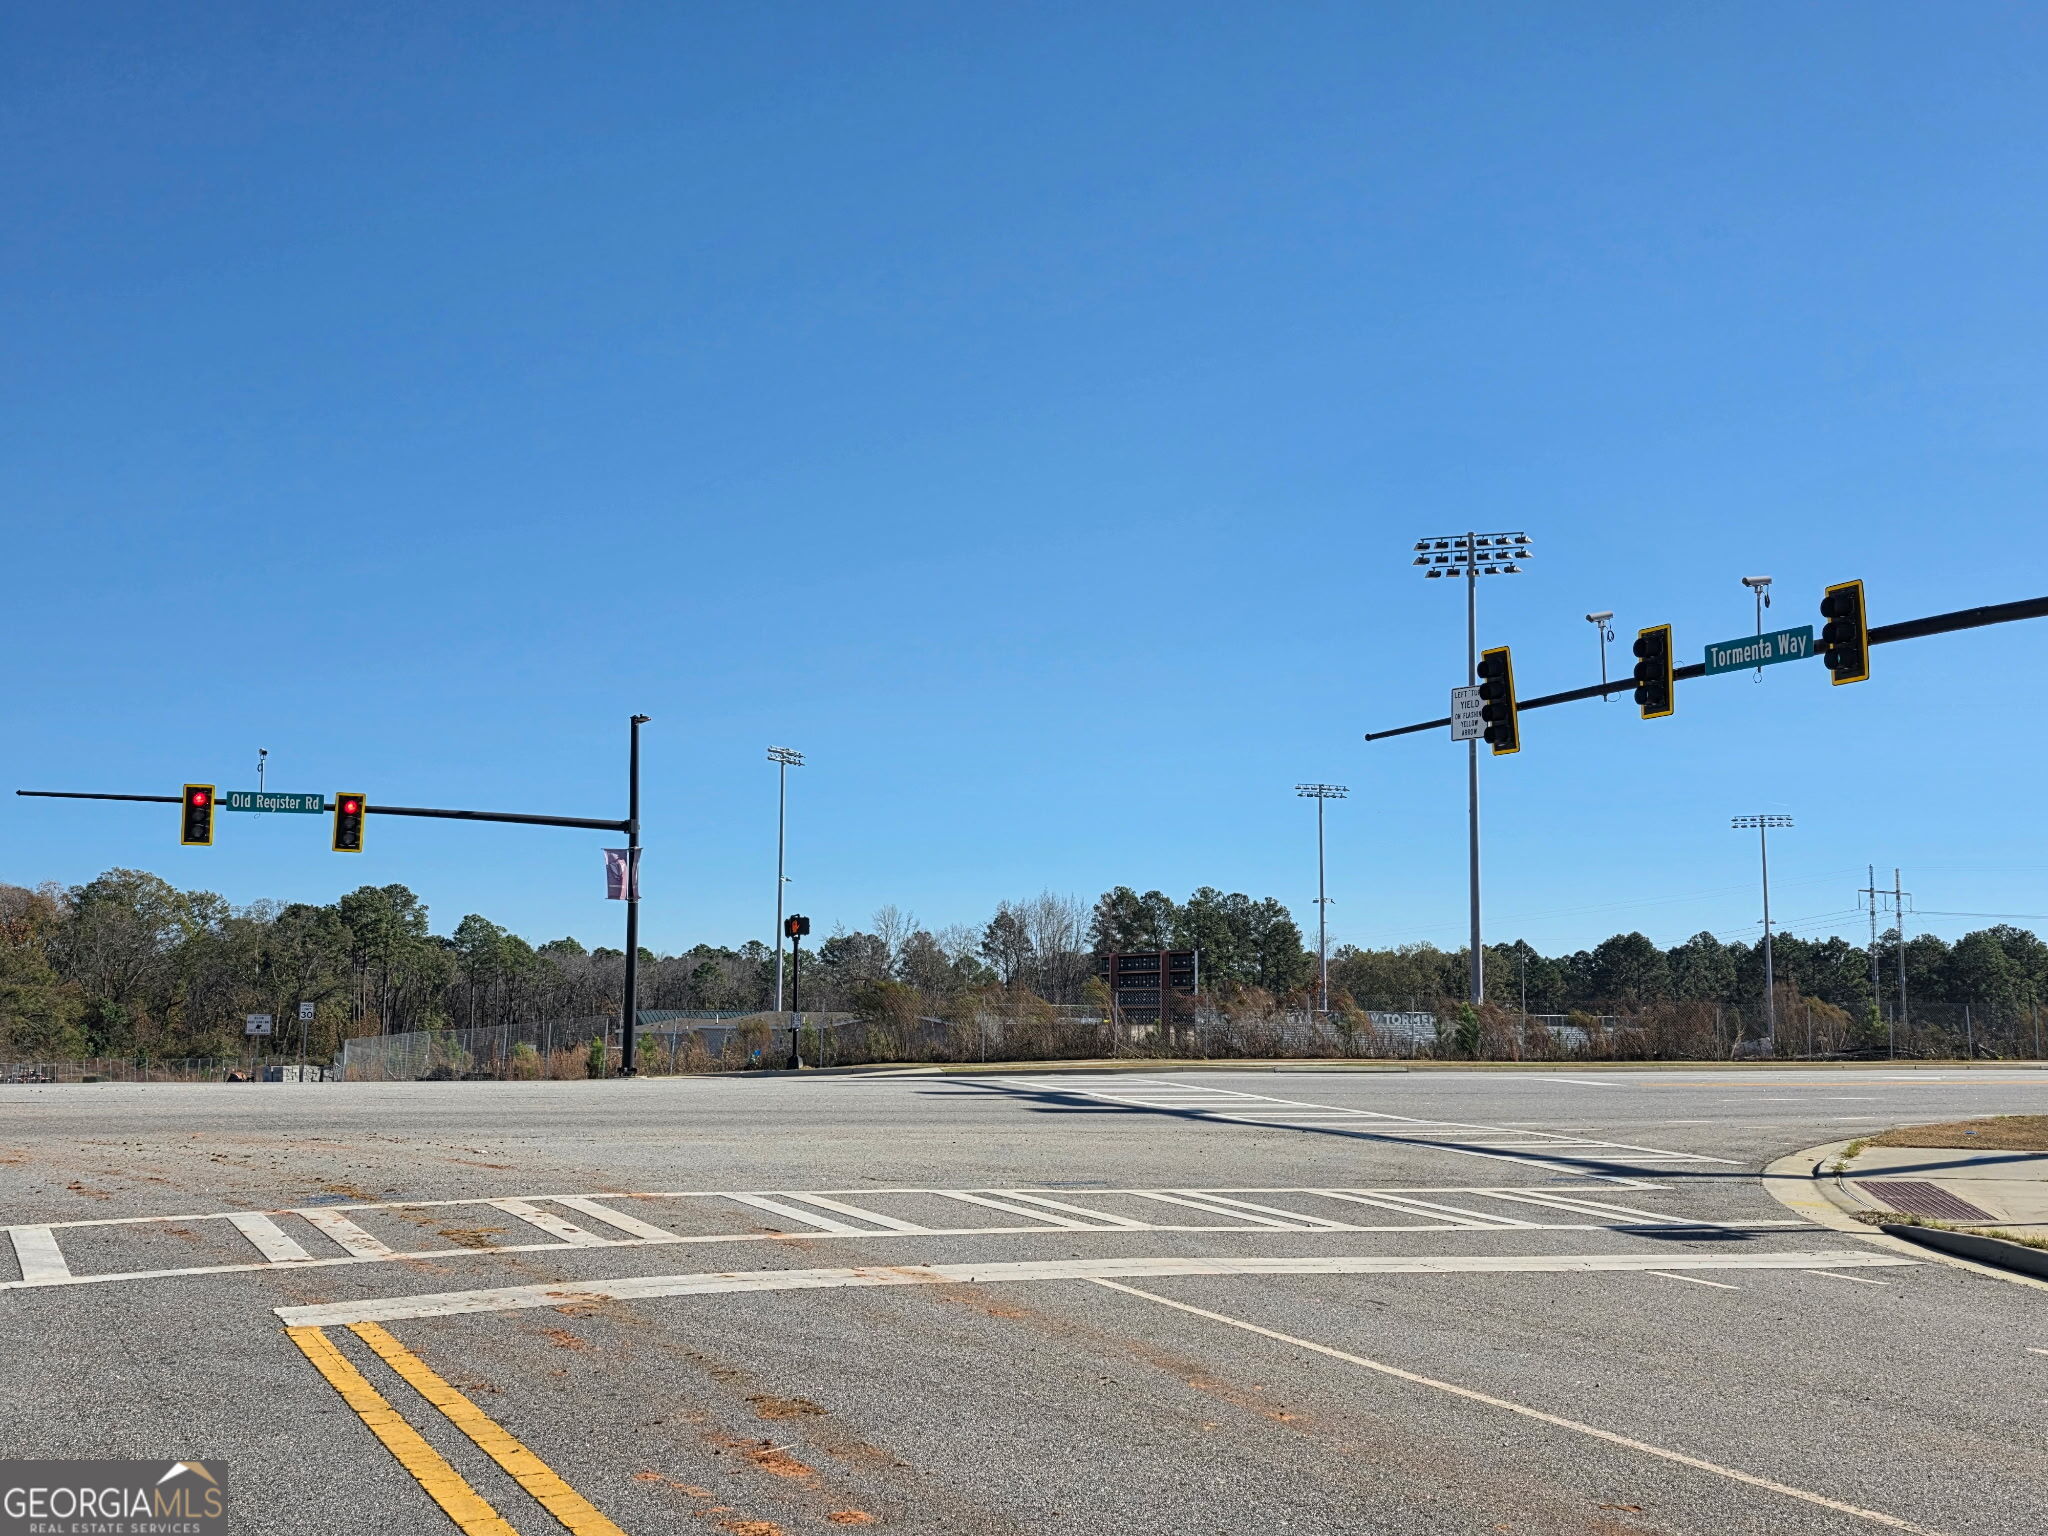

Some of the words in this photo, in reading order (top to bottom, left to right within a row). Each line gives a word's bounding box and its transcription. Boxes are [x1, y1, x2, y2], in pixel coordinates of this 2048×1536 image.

[1711, 638, 1772, 667] Tormenta
[1778, 633, 1807, 657] Way
[1454, 690, 1467, 699] LEFT
[1471, 689, 1480, 697] TUR
[1460, 700, 1480, 709] YIELD
[1463, 711, 1482, 719] FLASHIN
[1461, 720, 1478, 728] YELLOW
[232, 793, 251, 808] Old
[256, 794, 300, 813] Register
[305, 796, 320, 810] Rd
[1383, 1013, 1437, 1026] TORMEN
